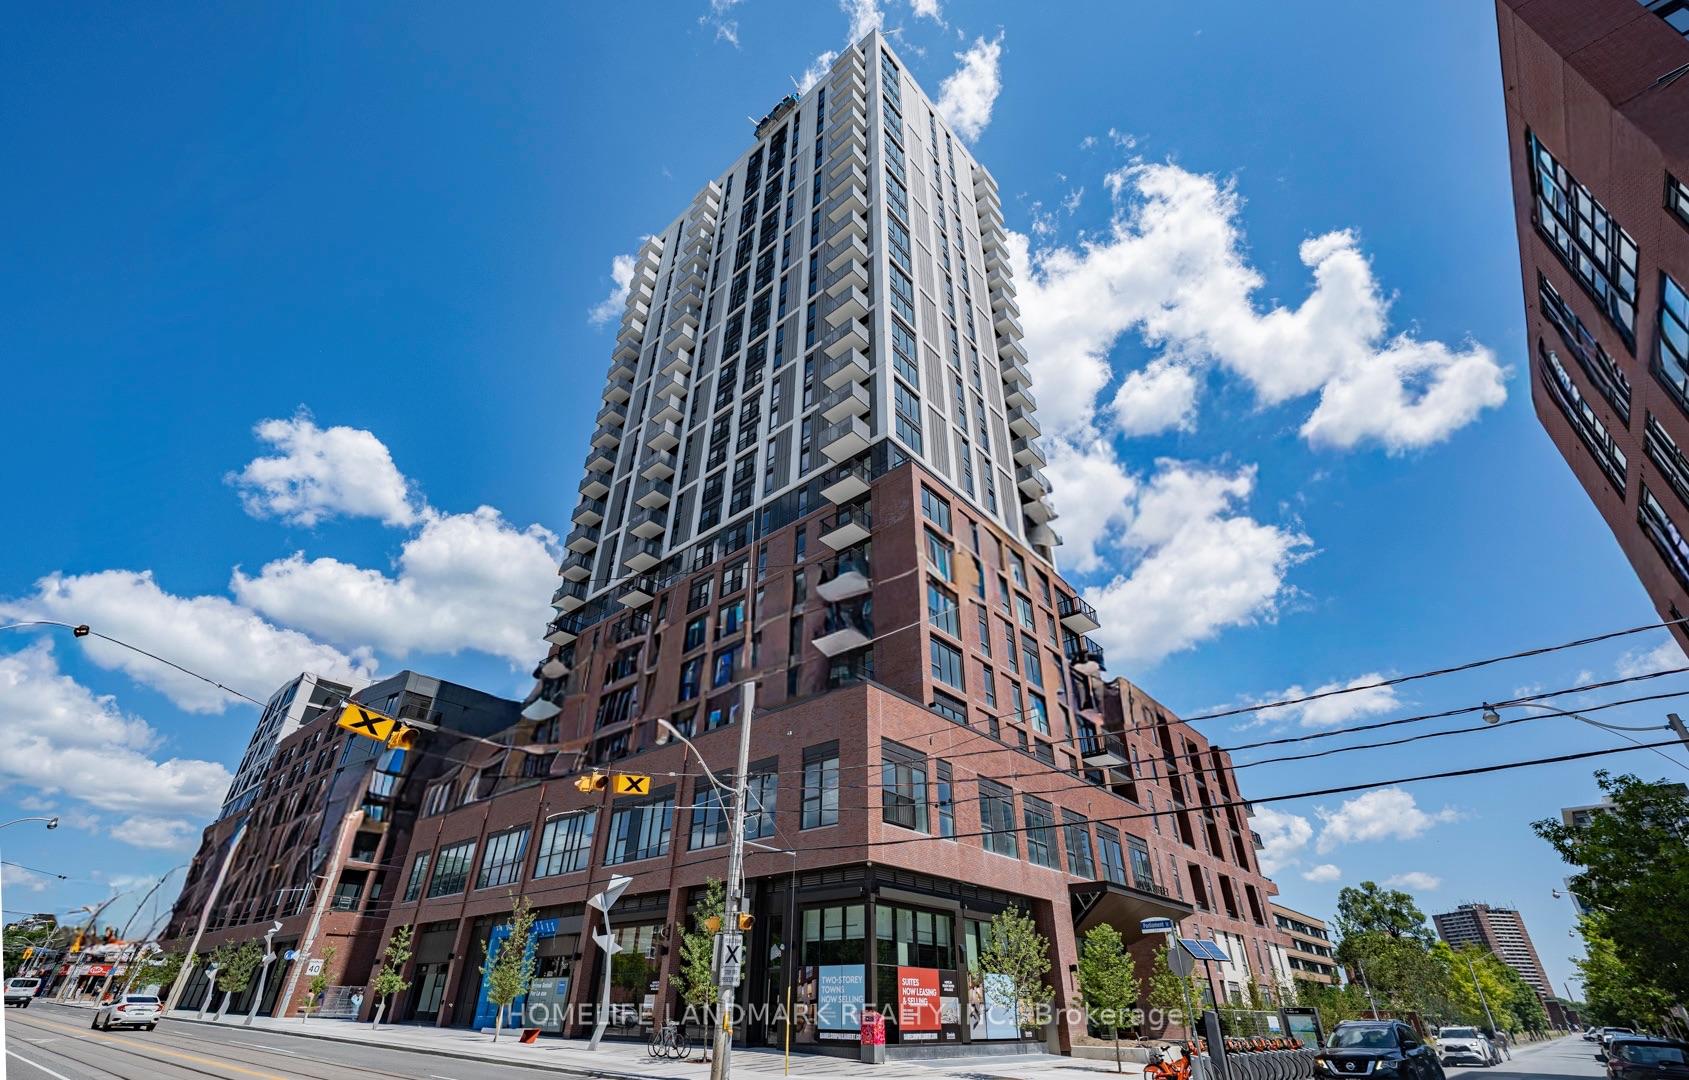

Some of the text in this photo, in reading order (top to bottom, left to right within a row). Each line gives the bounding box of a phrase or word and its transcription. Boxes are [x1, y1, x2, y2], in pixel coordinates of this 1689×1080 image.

[309, 965, 320, 973] 40
[821, 976, 863, 984] TWO-STOREY
[902, 978, 920, 986] SUITES
[902, 987, 937, 996] NOW LEASING
[821, 995, 865, 1003] NOW SELLING
[907, 997, 929, 1006] SELLING
